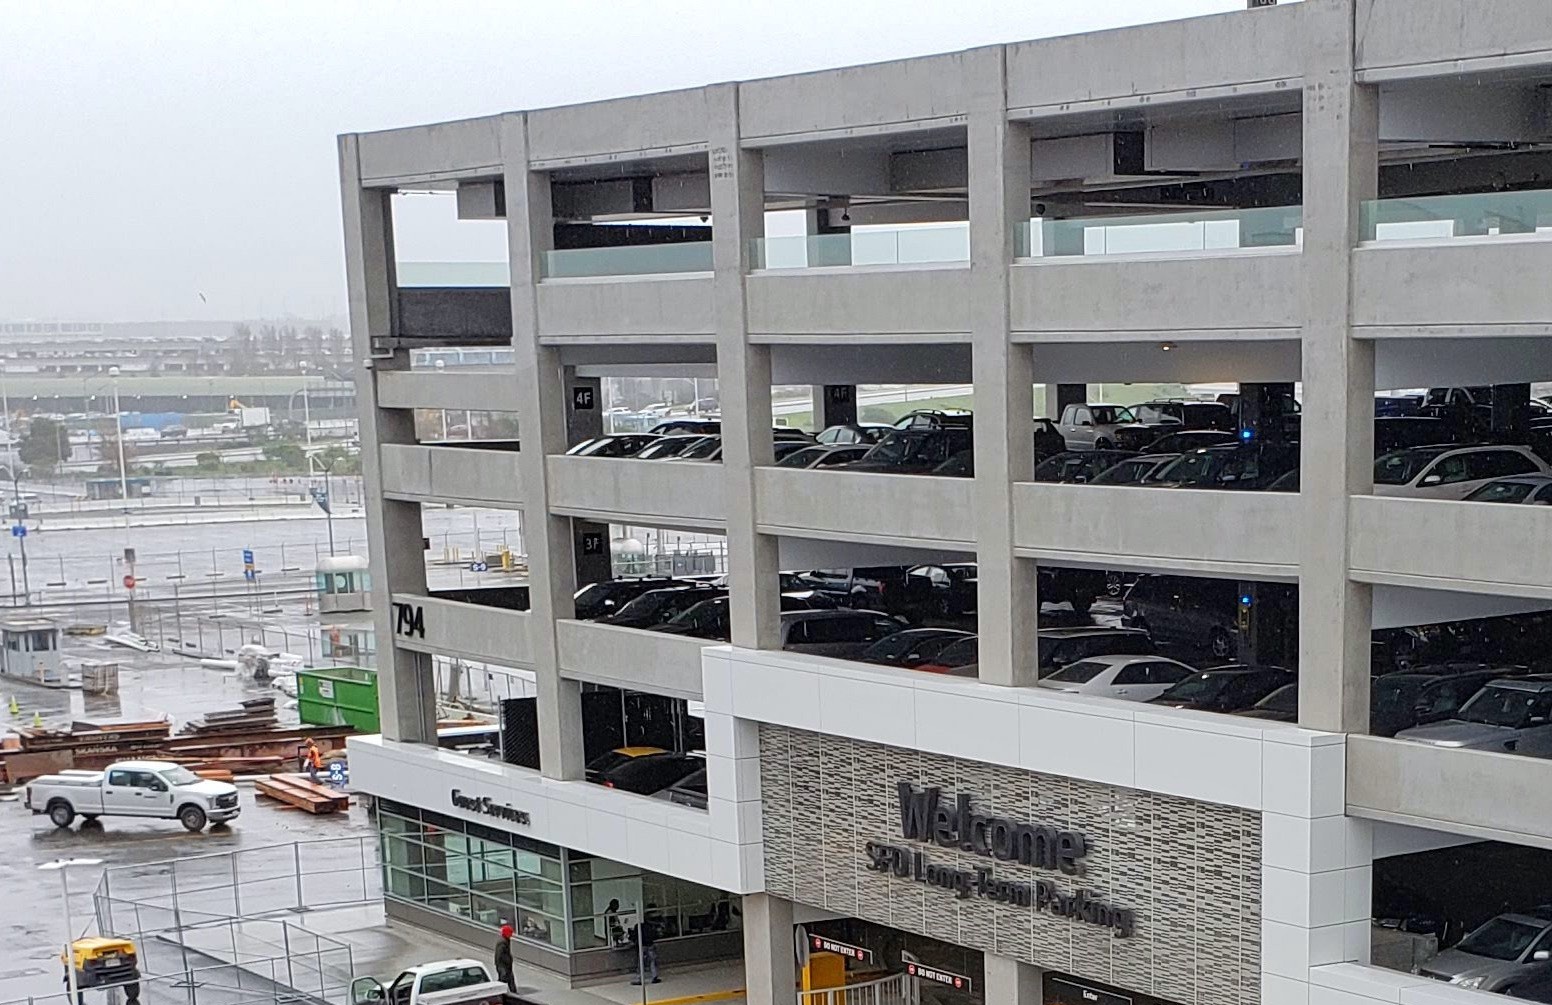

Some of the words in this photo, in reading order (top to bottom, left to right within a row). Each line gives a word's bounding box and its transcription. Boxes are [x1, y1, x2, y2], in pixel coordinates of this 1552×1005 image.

[576, 391, 591, 405] 4F
[392, 602, 425, 638] 794
[482, 797, 531, 825] Services
[897, 781, 1086, 875] Welcome
[866, 841, 914, 877] SFO
[1036, 880, 1136, 938] Parking
[823, 941, 831, 949] DO
[830, 943, 840, 951] NOT
[840, 946, 855, 956] ENTER
[917, 967, 925, 976] DO
[925, 969, 936, 979] NOT
[936, 972, 953, 984] ENTER
[1082, 989, 1098, 1001] Enter
